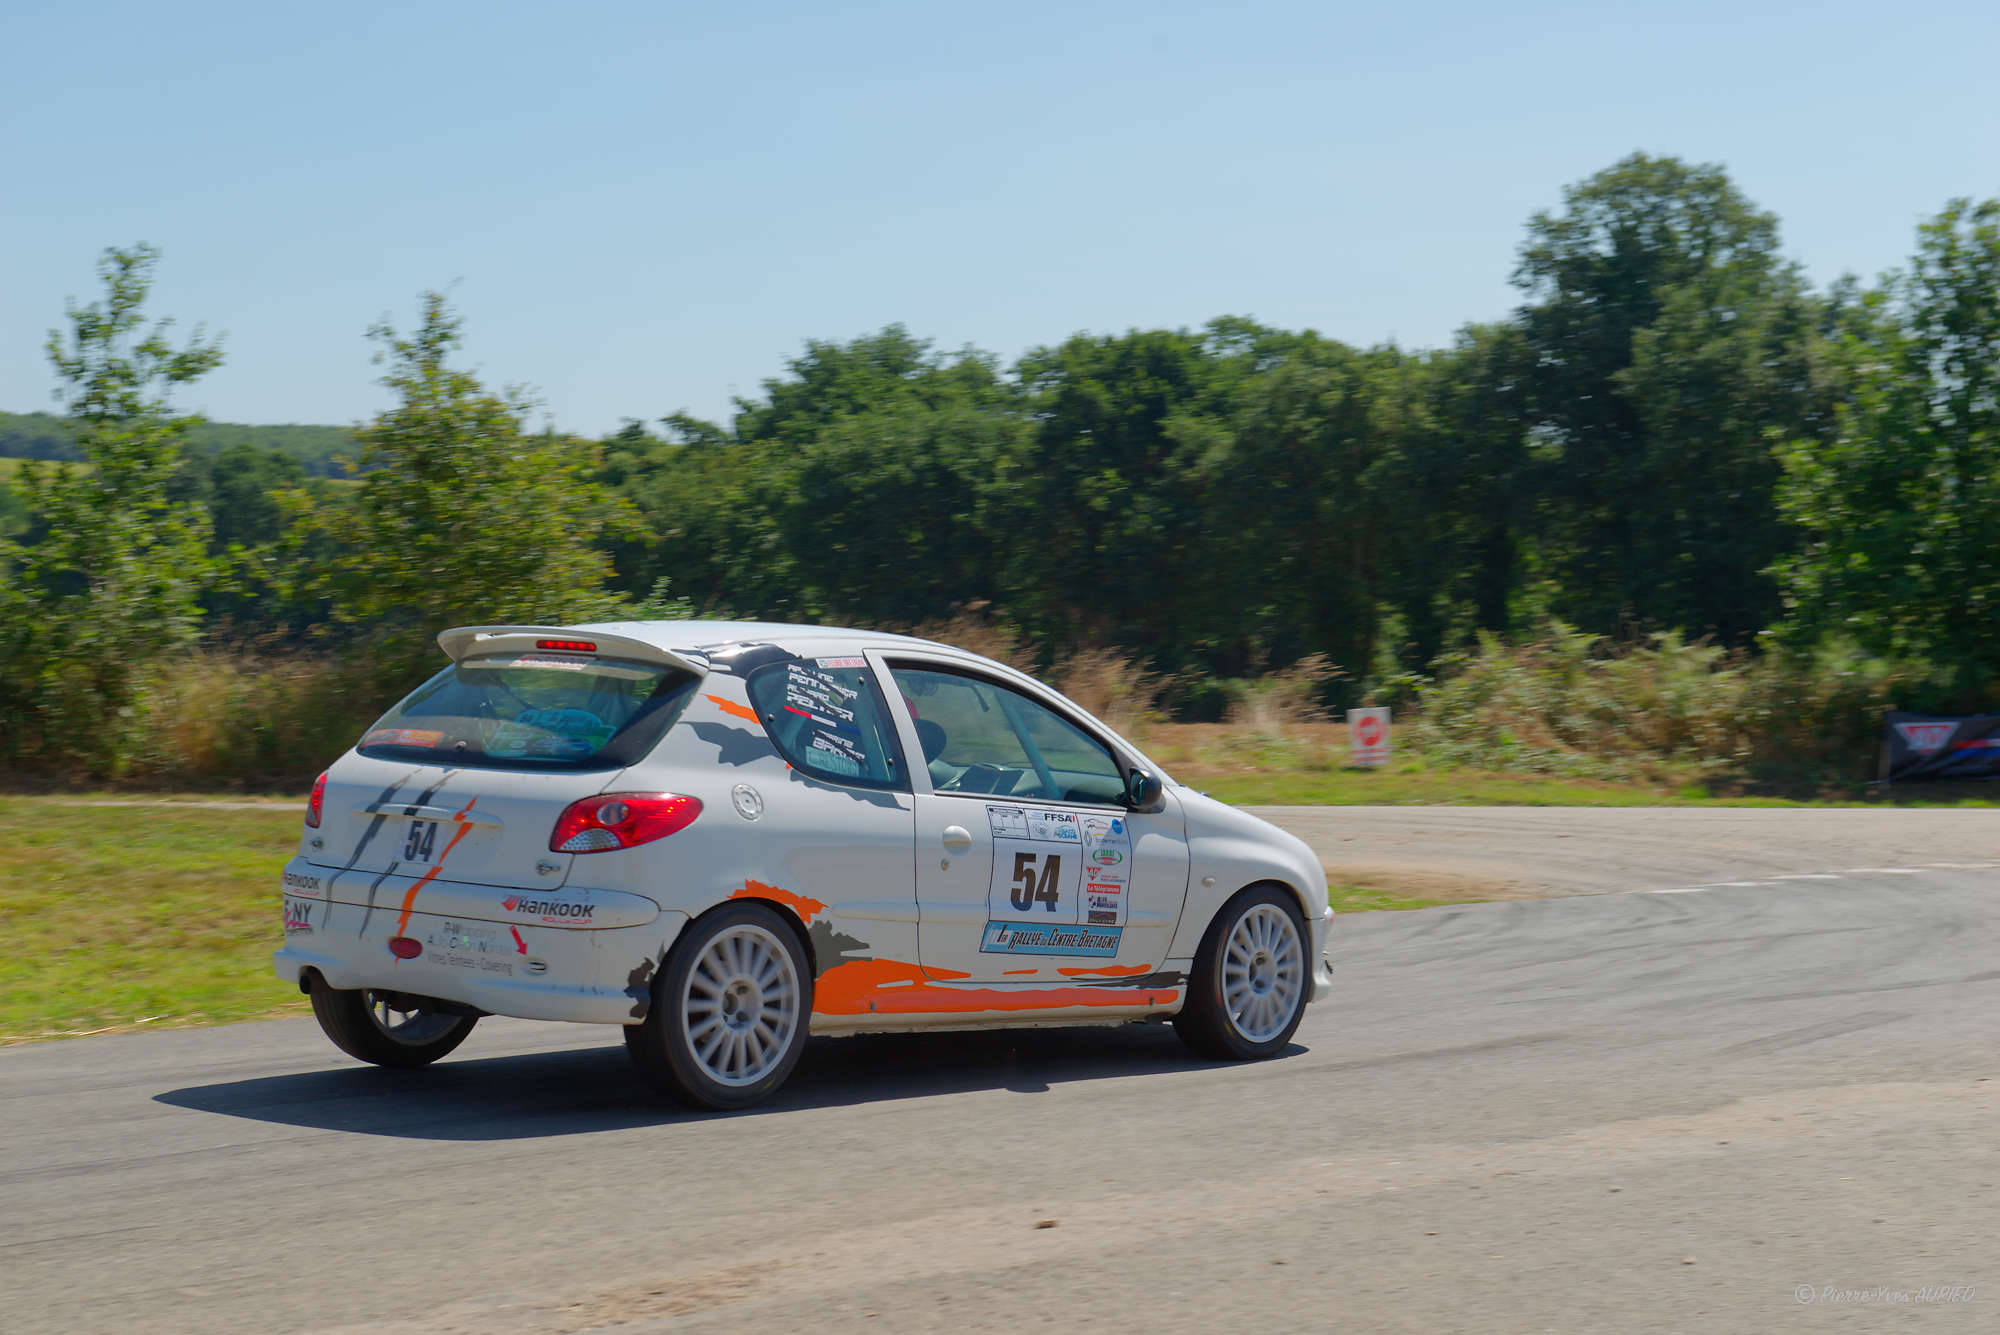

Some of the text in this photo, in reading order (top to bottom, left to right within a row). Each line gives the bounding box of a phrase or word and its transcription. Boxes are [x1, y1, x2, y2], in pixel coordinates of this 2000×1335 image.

[1044, 813, 1072, 823] FFSA
[403, 820, 438, 863] 54
[1010, 851, 1061, 913] 54
[1008, 931, 1042, 949] RALLYE
[1047, 927, 1119, 950] CENTRE-BRETAGNE
